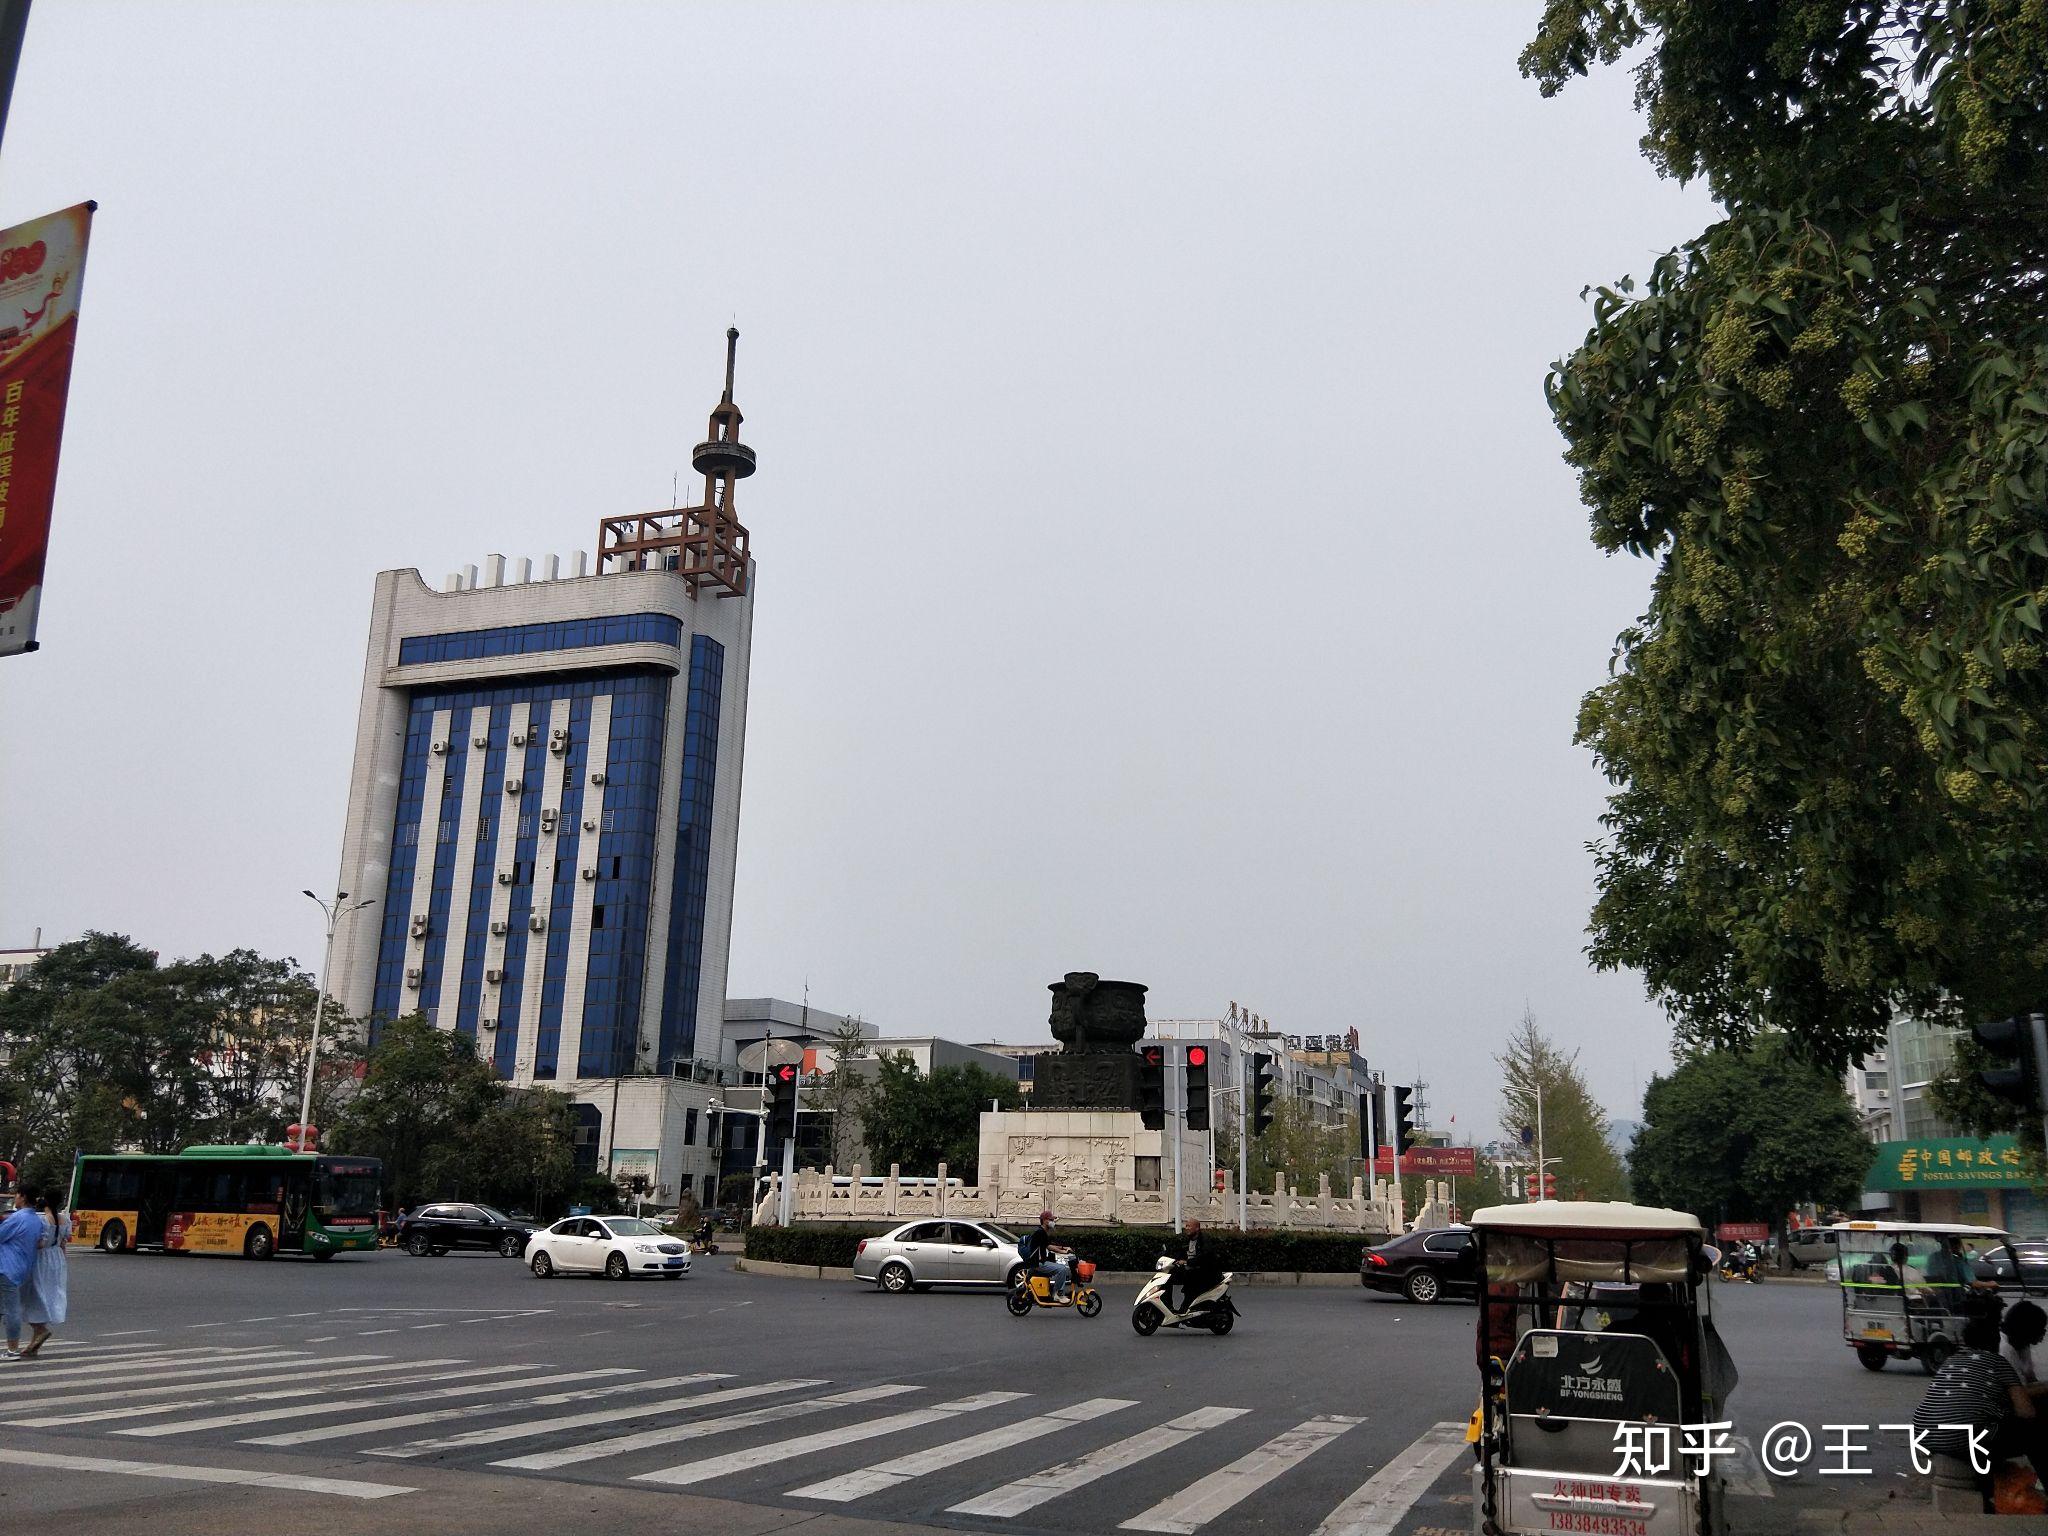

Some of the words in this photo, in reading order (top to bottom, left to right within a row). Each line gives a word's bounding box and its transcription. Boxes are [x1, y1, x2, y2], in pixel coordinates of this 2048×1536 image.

[1922, 1172, 1954, 1181] POSTAL
[1957, 1171, 2002, 1180] SAVINGS
[1560, 1375, 1622, 1392] 北方永盛
[1553, 1479, 1642, 1504] 火神凹专卖
[1551, 1511, 1647, 1536] 13838493534
